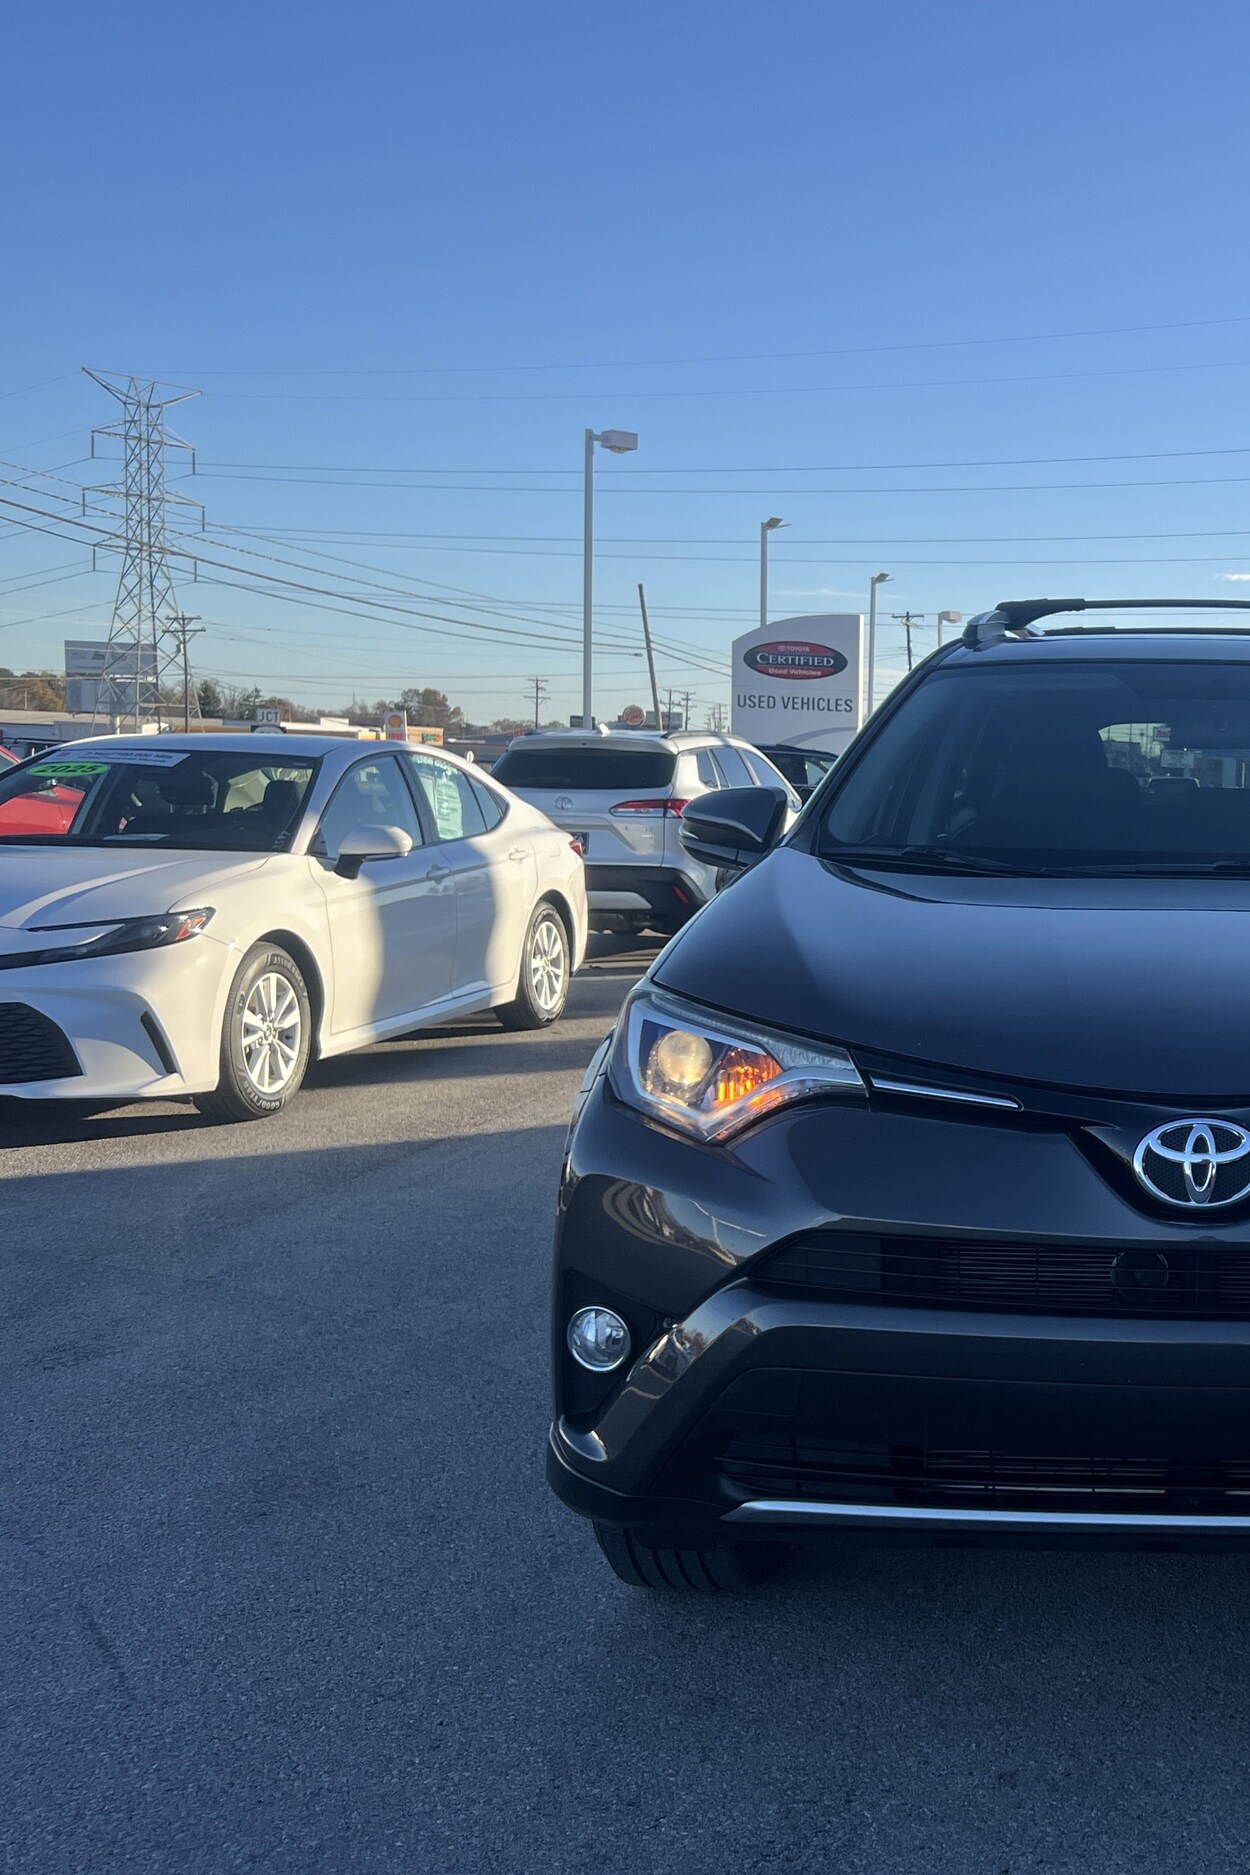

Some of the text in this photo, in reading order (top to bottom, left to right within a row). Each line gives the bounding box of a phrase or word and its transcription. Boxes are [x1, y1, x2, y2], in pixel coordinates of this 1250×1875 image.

[756, 652, 834, 667] CERTIFIED
[789, 668, 822, 676] Vehicles
[737, 694, 853, 713] USED VEHICLES
[259, 710, 278, 722] JCT
[35, 765, 99, 774] 2025
